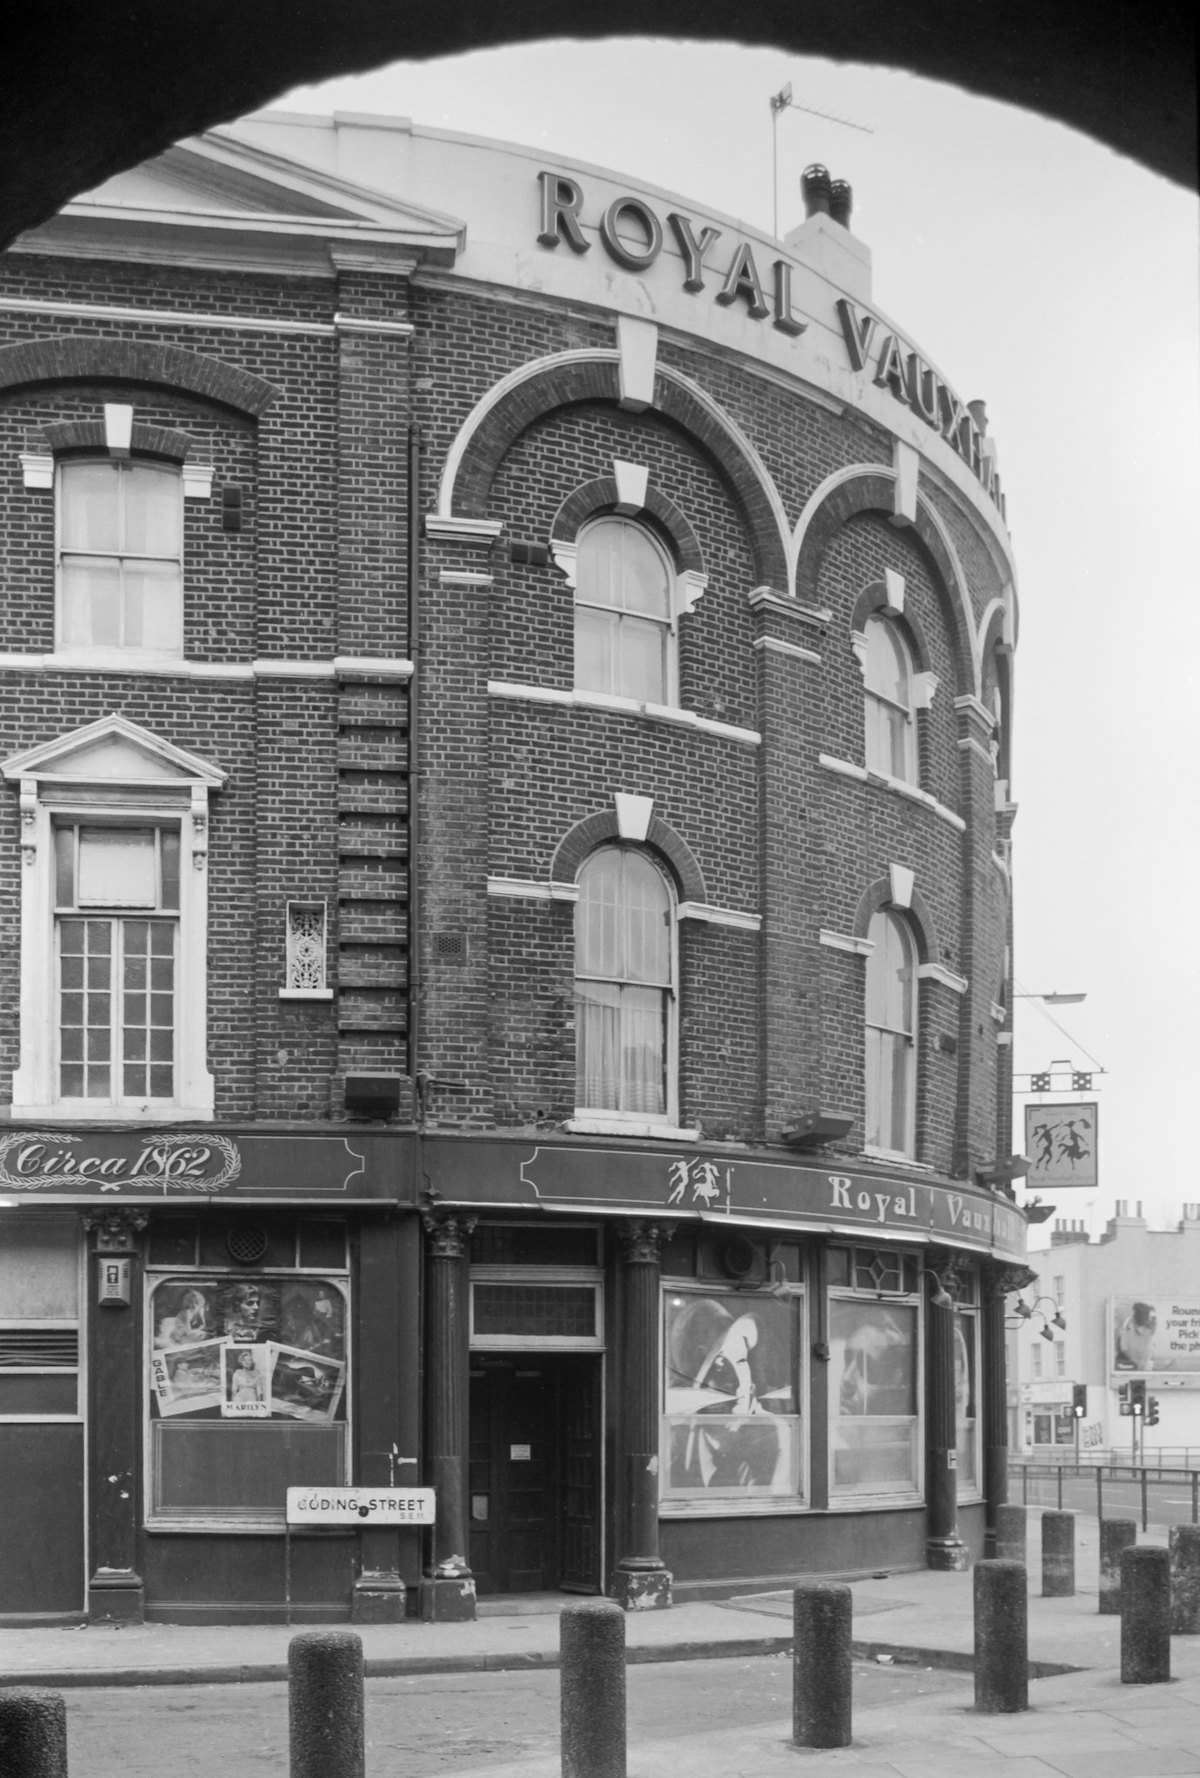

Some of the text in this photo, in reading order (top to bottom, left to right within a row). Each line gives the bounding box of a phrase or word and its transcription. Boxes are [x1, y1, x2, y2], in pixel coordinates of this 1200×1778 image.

[537, 170, 1006, 526] ROYAL VAUXHA
[16, 1144, 210, 1176] Circa 1862
[828, 1176, 917, 1223] Royal
[369, 1498, 425, 1511] STREET
